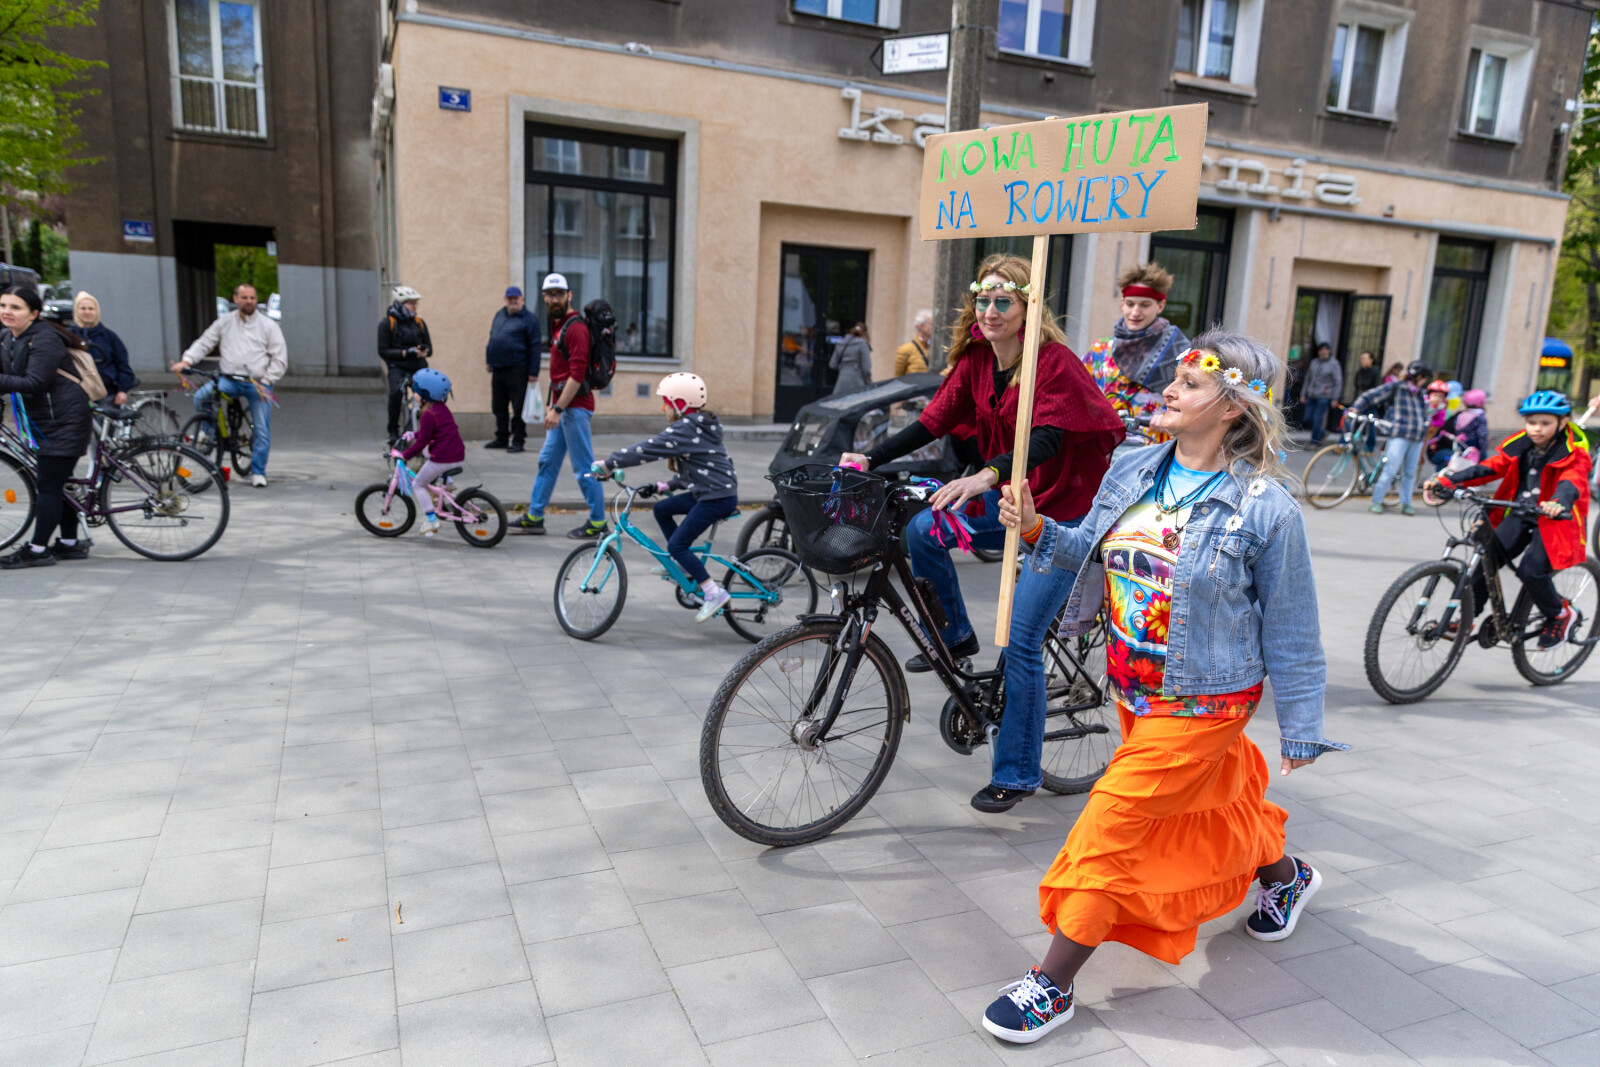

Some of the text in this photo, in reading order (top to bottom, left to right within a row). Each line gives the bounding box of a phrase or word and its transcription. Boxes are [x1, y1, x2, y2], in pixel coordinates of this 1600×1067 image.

[936, 113, 1182, 183] NOWA HUTA
[936, 170, 1168, 229] NA ROWERY
[900, 605, 940, 662] UNIBIKE
